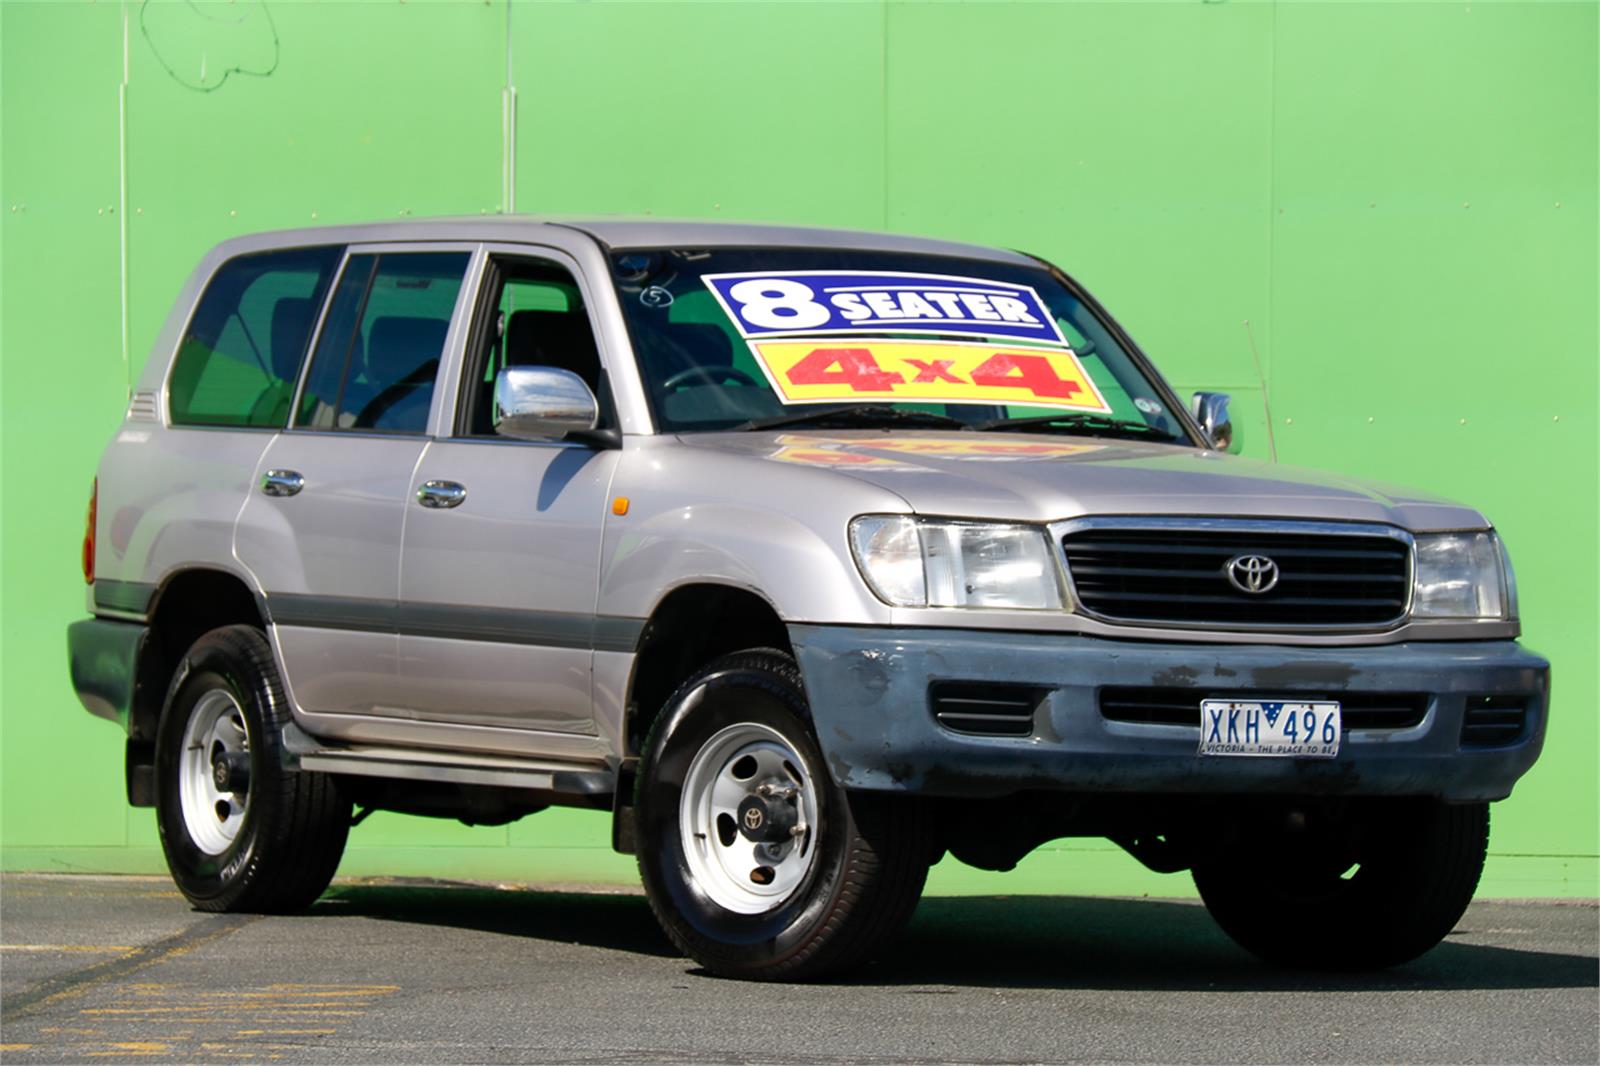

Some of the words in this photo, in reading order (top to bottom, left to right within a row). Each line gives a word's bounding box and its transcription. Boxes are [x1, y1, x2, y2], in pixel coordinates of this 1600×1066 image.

[730, 278, 831, 329] 8
[830, 291, 1042, 325] SEATER
[1208, 709, 1260, 744] XKH
[1283, 710, 1335, 744] 496
[1206, 744, 1245, 753] VICTORIA
[1258, 745, 1273, 753] THE
[1276, 745, 1302, 754] PLACE
[1307, 746, 1318, 754] TO
[1321, 746, 1332, 754] BE
